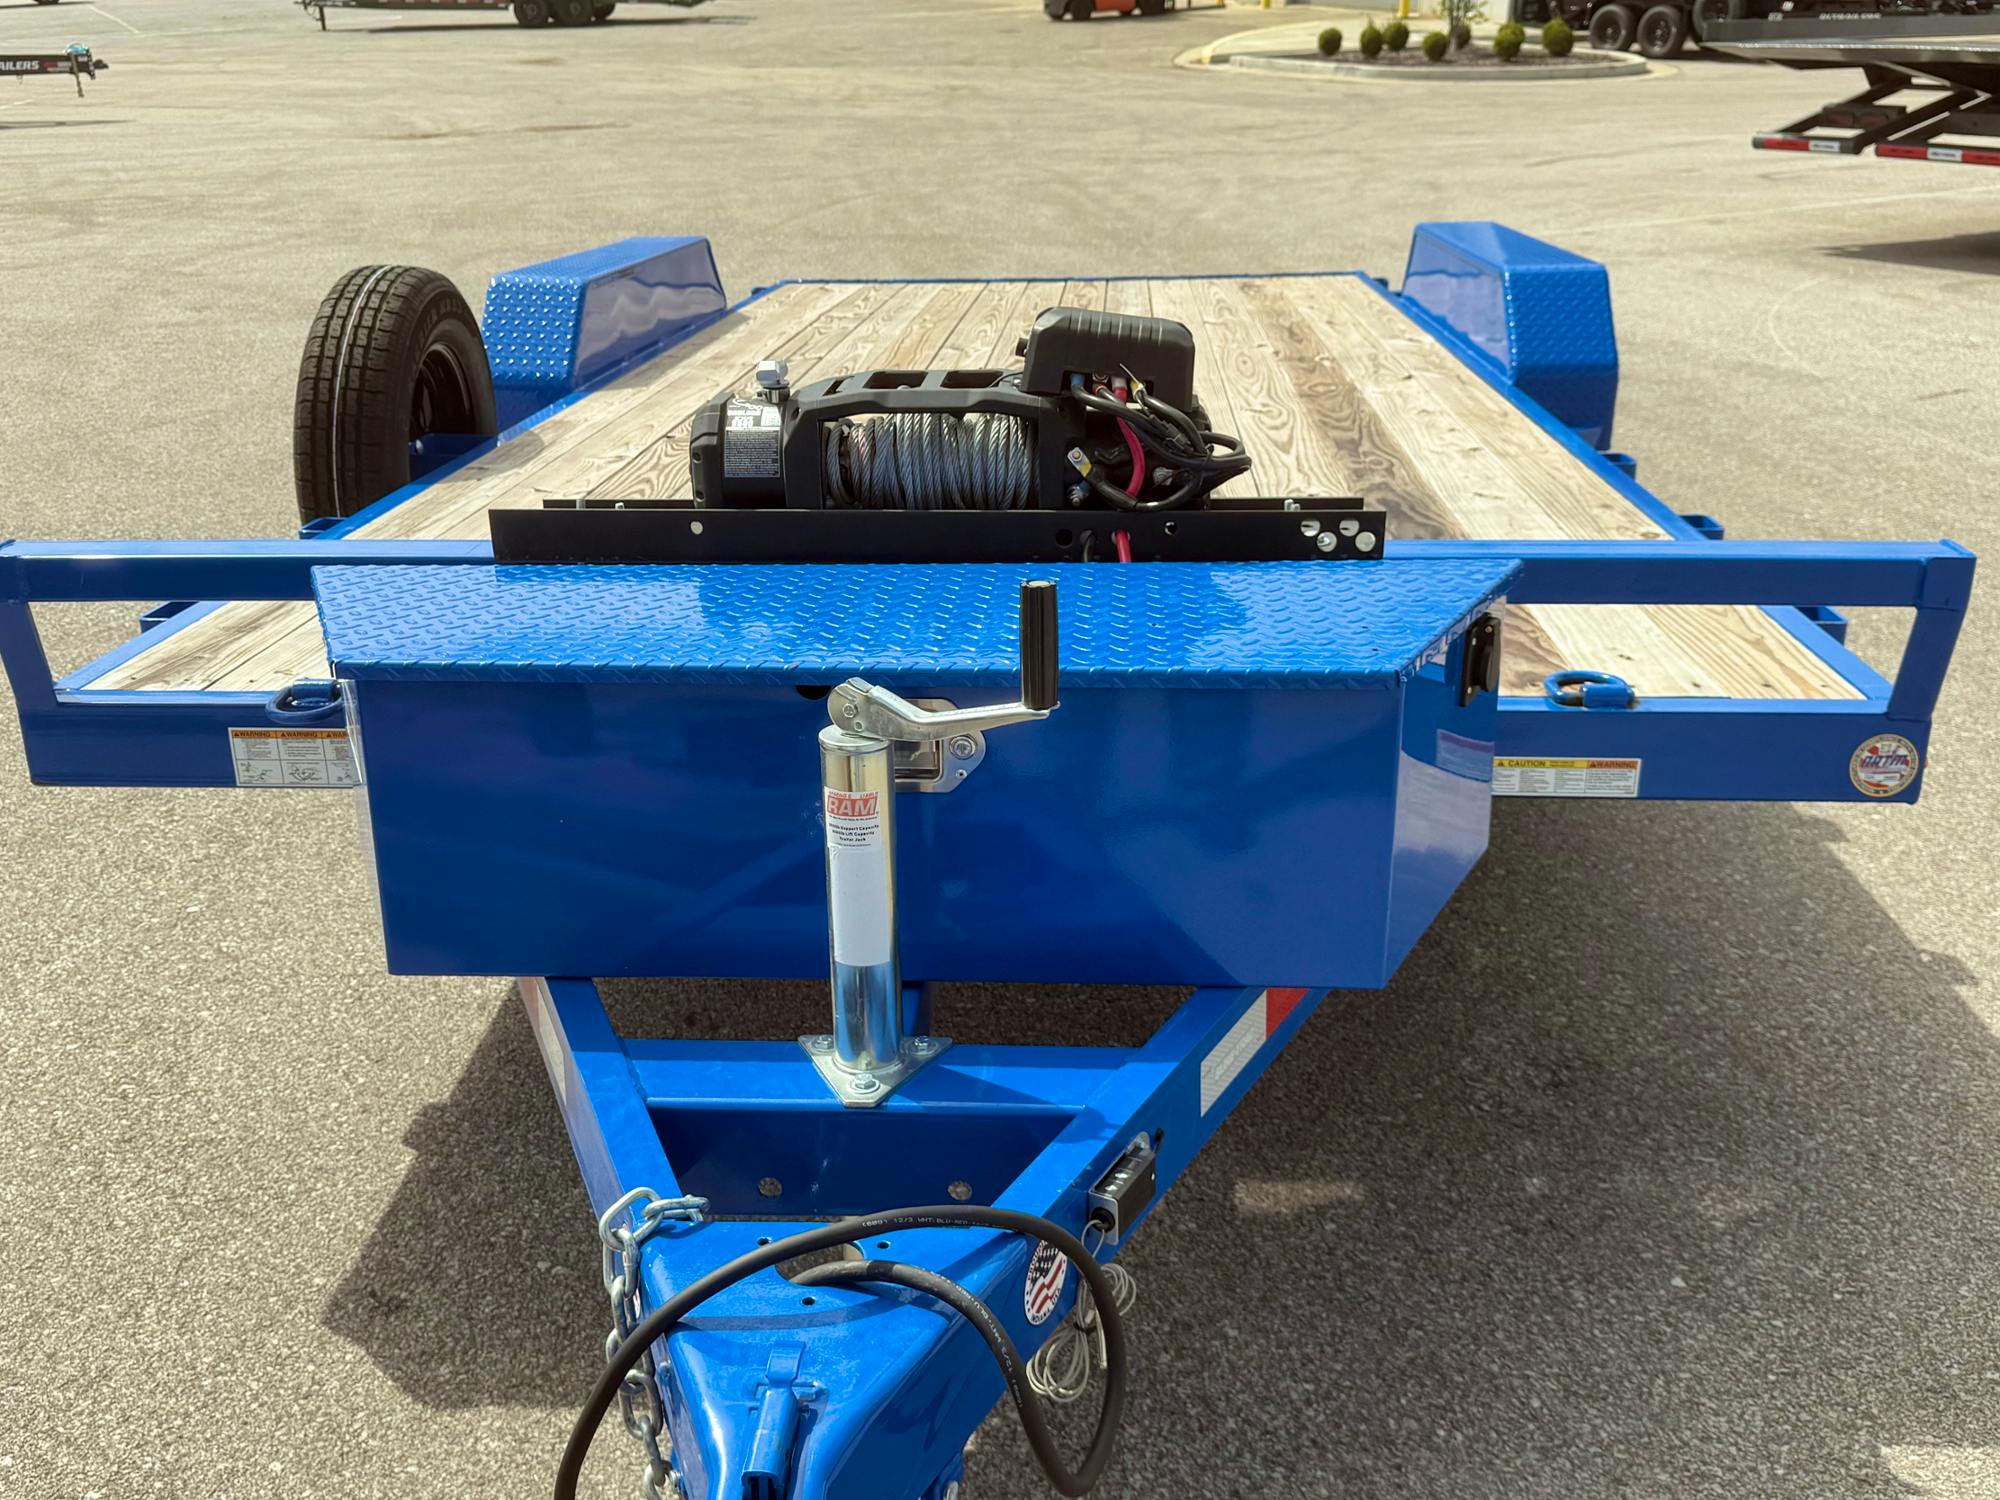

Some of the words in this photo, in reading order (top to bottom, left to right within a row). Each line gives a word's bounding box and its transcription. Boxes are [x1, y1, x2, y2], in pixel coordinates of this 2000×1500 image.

[1508, 760, 1546, 768] CAUTION
[1597, 761, 1637, 769] WARNING
[828, 797, 876, 816] RAM
